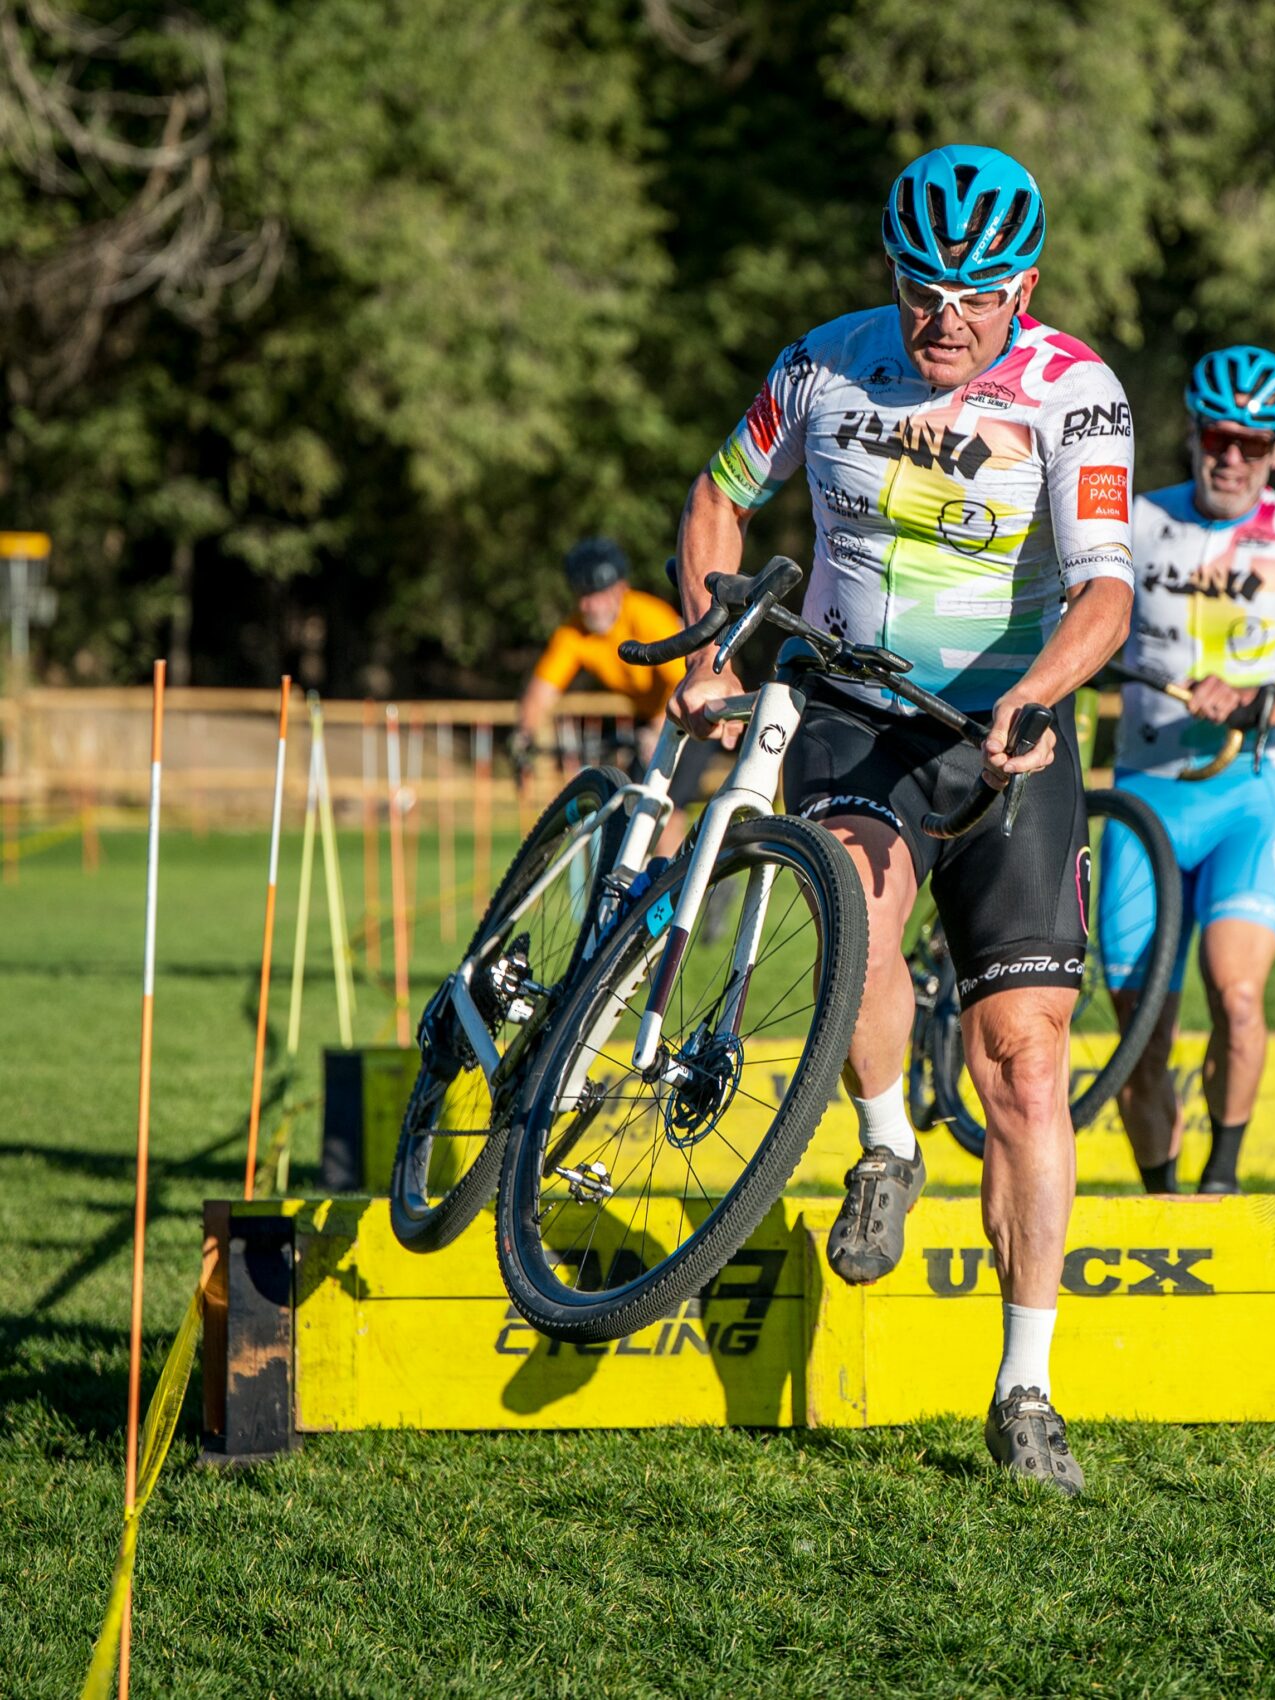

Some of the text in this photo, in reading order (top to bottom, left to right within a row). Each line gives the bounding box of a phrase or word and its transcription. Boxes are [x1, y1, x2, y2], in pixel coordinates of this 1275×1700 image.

[1062, 402, 1131, 435] DNA
[1061, 425, 1131, 446] CYCLING
[1081, 473, 1127, 489] FOWLER
[1090, 488, 1122, 502] PACK
[962, 509, 976, 525] 7
[1064, 555, 1125, 569] MARKOSIAN
[922, 1247, 1214, 1297] UCX
